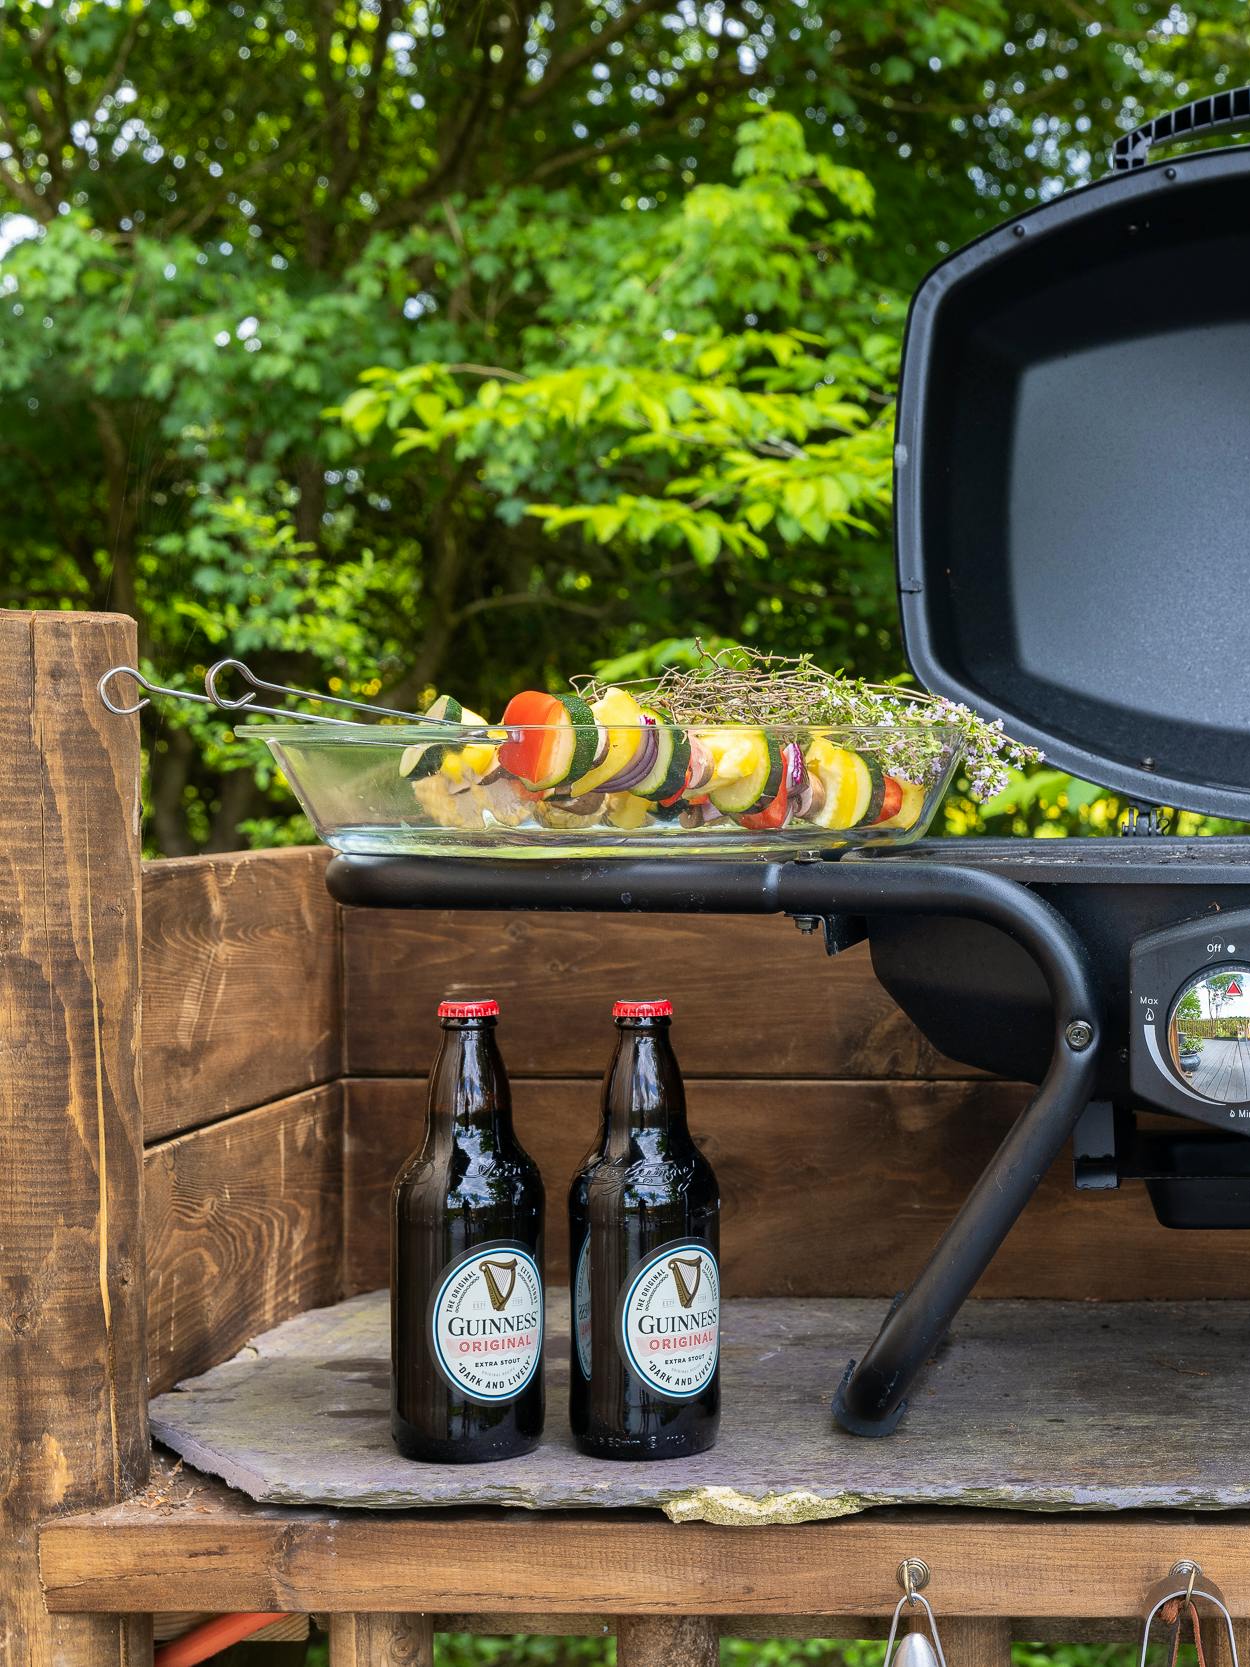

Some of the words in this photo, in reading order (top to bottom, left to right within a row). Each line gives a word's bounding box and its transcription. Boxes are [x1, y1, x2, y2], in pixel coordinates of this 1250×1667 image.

[1206, 943, 1222, 953] Off
[1139, 996, 1159, 1005] Max
[446, 1299, 456, 1313] THE
[451, 1270, 477, 1299] ORIGINAL
[636, 1298, 646, 1312] THE
[641, 1268, 666, 1297] ORIGINAL
[447, 1311, 538, 1337] GUINNESS
[458, 1334, 532, 1353] ORIGINAL
[648, 1331, 713, 1350] ORIGINAL
[500, 1357, 521, 1366] STOUT
[688, 1354, 705, 1362] STOUT
[485, 1380, 505, 1390] AND
[674, 1377, 692, 1386] AND
